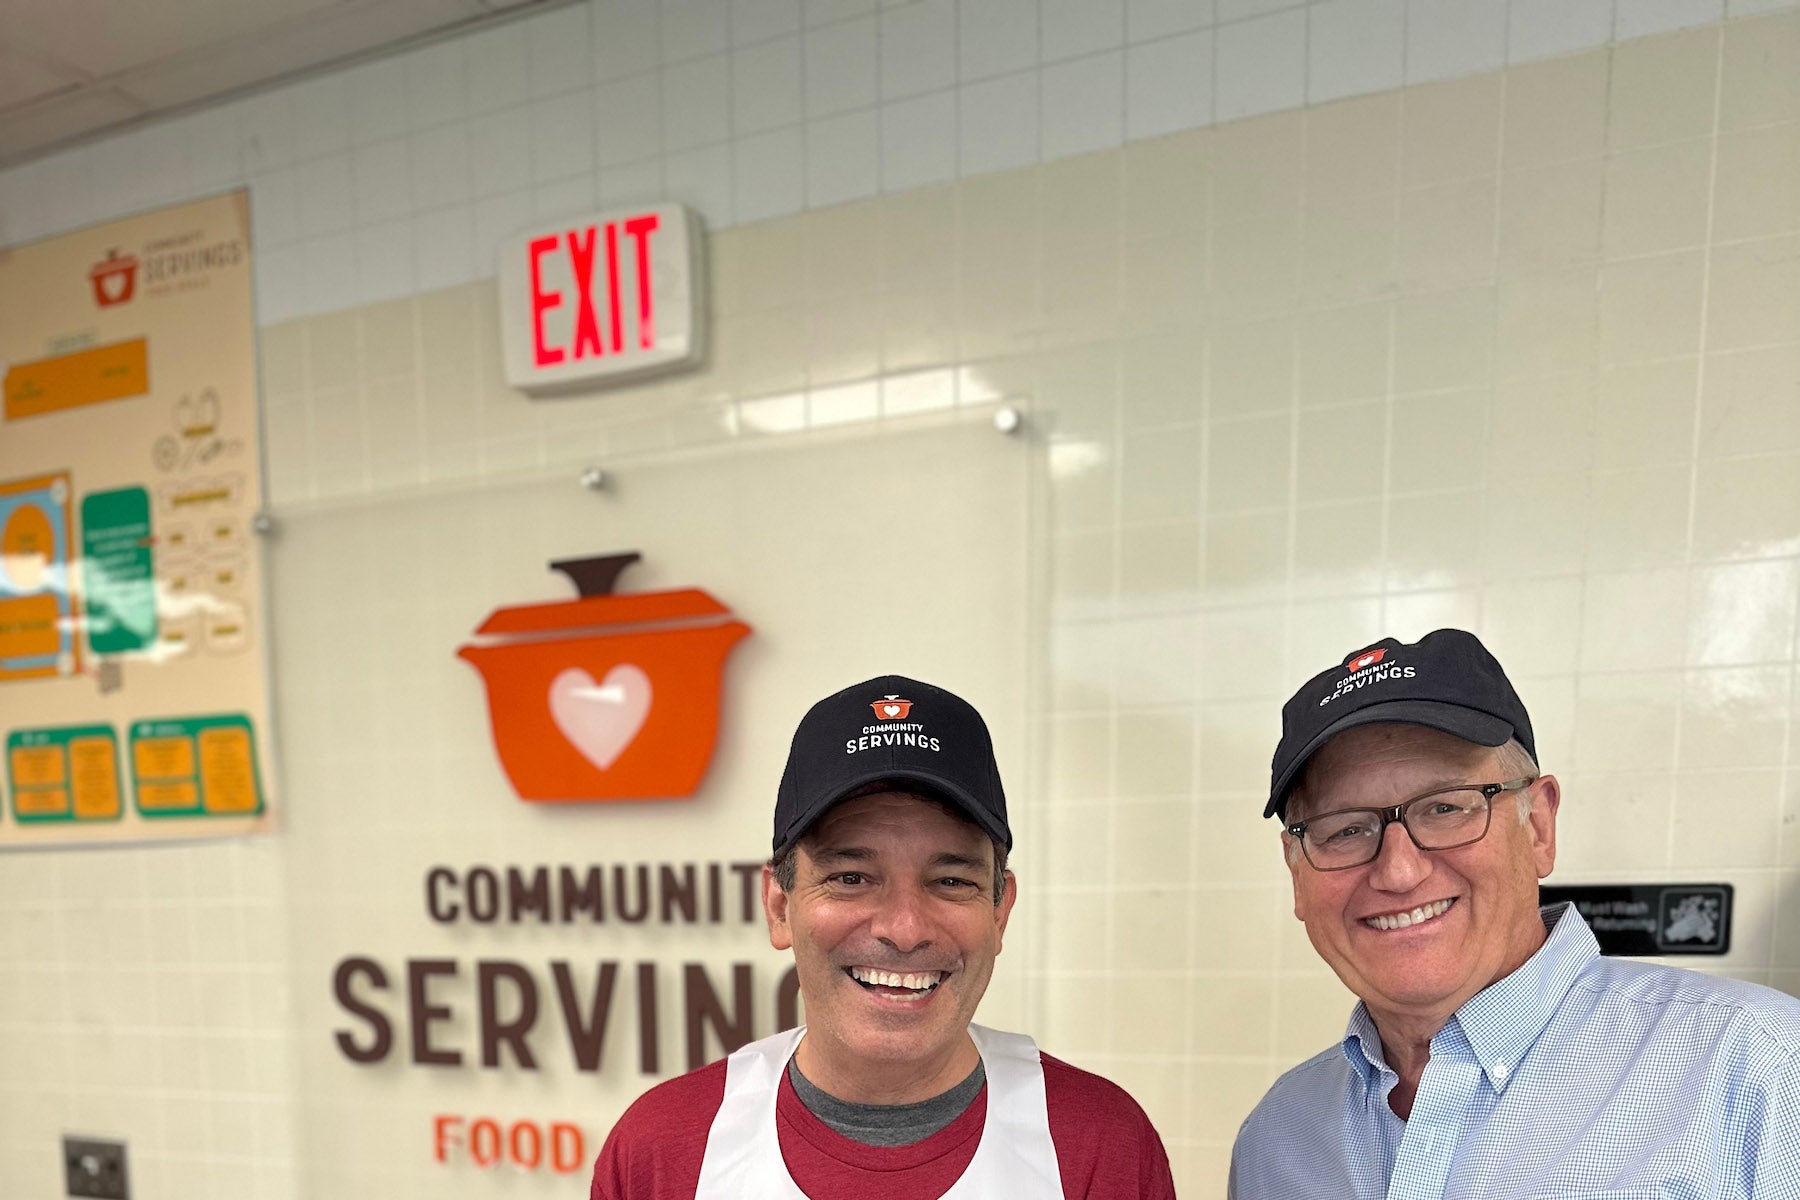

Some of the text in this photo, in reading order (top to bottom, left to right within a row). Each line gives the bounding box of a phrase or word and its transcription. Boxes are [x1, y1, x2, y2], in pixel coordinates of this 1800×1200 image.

[527, 214, 659, 370] EXIT
[1319, 666, 1417, 707] SERVINGS
[1336, 659, 1396, 690] COMMUNITY
[846, 732, 941, 754] SERVINGS
[862, 723, 924, 735] COMMUNITY
[426, 862, 764, 925] COMMUNIT
[332, 956, 802, 1076] SERVIN
[432, 1114, 585, 1174] FOOD
